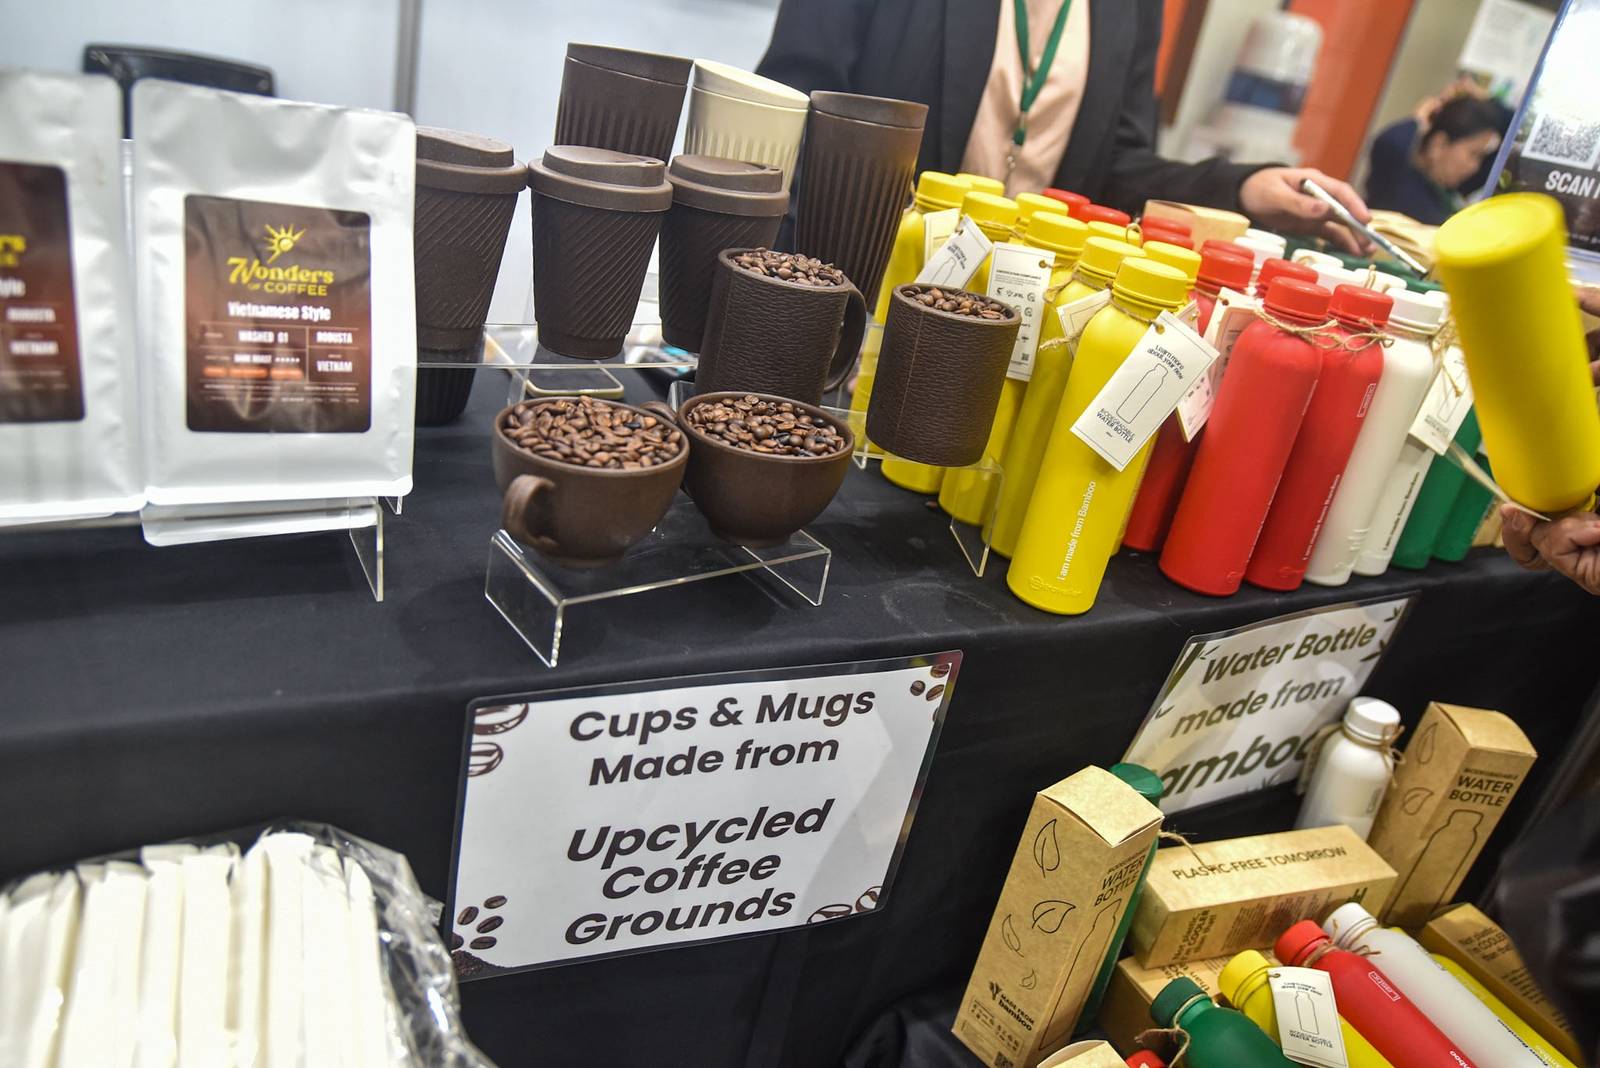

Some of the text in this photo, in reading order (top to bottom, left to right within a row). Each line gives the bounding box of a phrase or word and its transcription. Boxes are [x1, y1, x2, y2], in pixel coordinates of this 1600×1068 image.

[1545, 170, 1596, 199] SCAN
[264, 282, 328, 296] COFFEE
[227, 301, 332, 322] Vietnamese Style
[238, 330, 274, 344] WASHED
[316, 331, 353, 344] ROBUSTA
[316, 360, 353, 373] VIETNAM
[1147, 348, 1163, 360] about
[1174, 368, 1184, 380] new
[1170, 355, 1184, 370] more
[1097, 411, 1133, 444] WATER BOTTLE
[1077, 480, 1096, 518] Bamboo
[1070, 517, 1085, 538] from
[1065, 538, 1079, 563] made
[1060, 562, 1070, 578] am
[1202, 624, 1377, 685] Water Bottle
[569, 691, 876, 745] Cups & Mugs
[1169, 676, 1346, 738] made from
[588, 739, 840, 786] Made from
[1448, 789, 1506, 807] BOTTLE
[1458, 775, 1514, 794] WATER
[566, 798, 836, 870] Upcycled
[1102, 854, 1146, 889] WATER
[1265, 846, 1348, 867] TOMORROW
[602, 852, 782, 899] Coffee
[1094, 870, 1139, 906] BOTTLE
[564, 888, 796, 945] Grounds
[998, 999, 1032, 1031] bamboo
[1000, 993, 1035, 1025] MADE FROM
